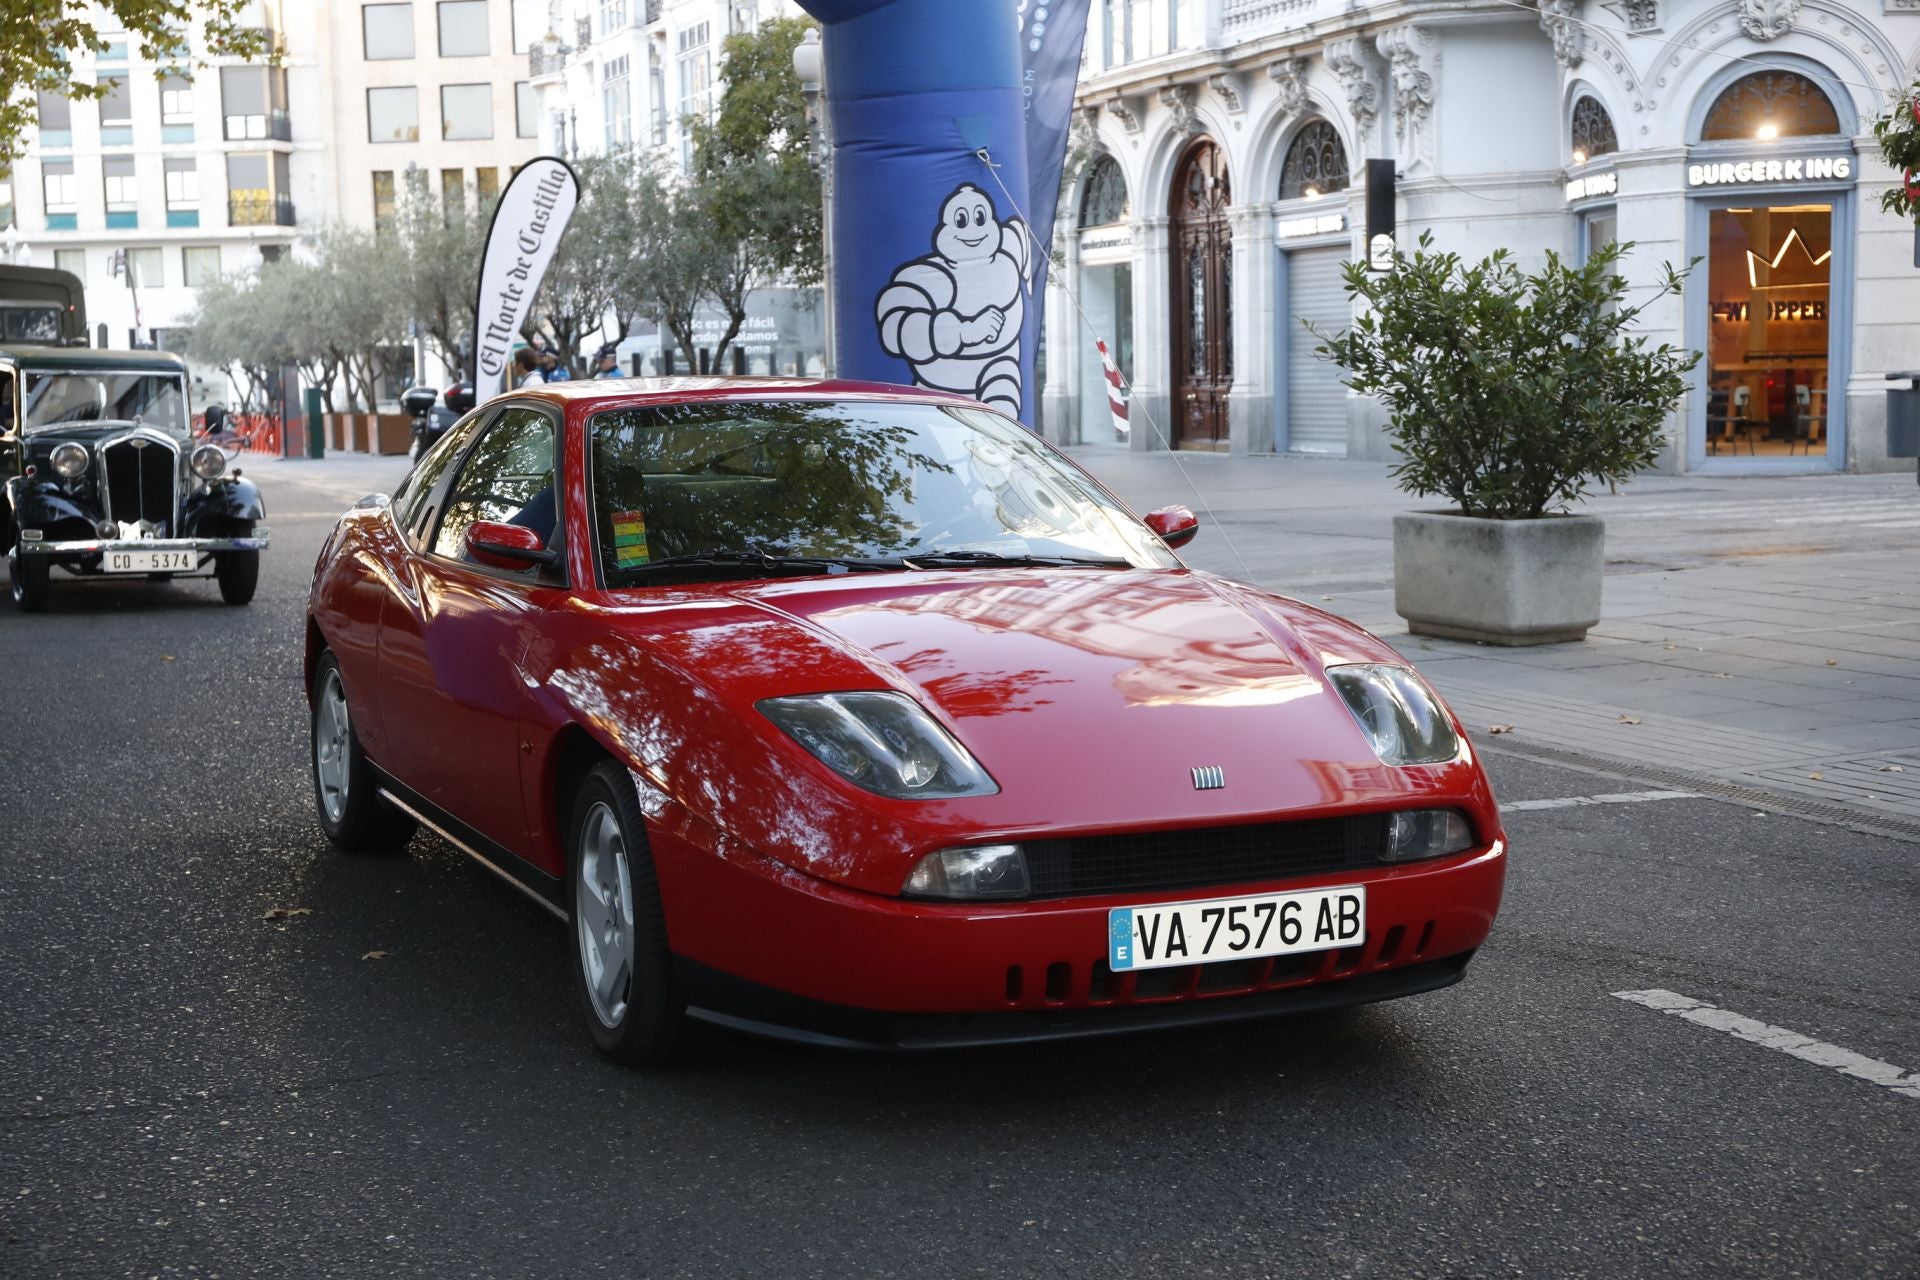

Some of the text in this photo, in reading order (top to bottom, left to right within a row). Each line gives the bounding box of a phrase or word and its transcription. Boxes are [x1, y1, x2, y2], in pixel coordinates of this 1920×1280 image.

[1689, 160, 1782, 185] BURGER
[480, 168, 568, 376] El Norte de Castilla
[748, 316, 775, 328] fácil
[113, 553, 131, 568] CO
[151, 553, 189, 568] 5374
[1117, 894, 1361, 960] E VA 7576 AB
